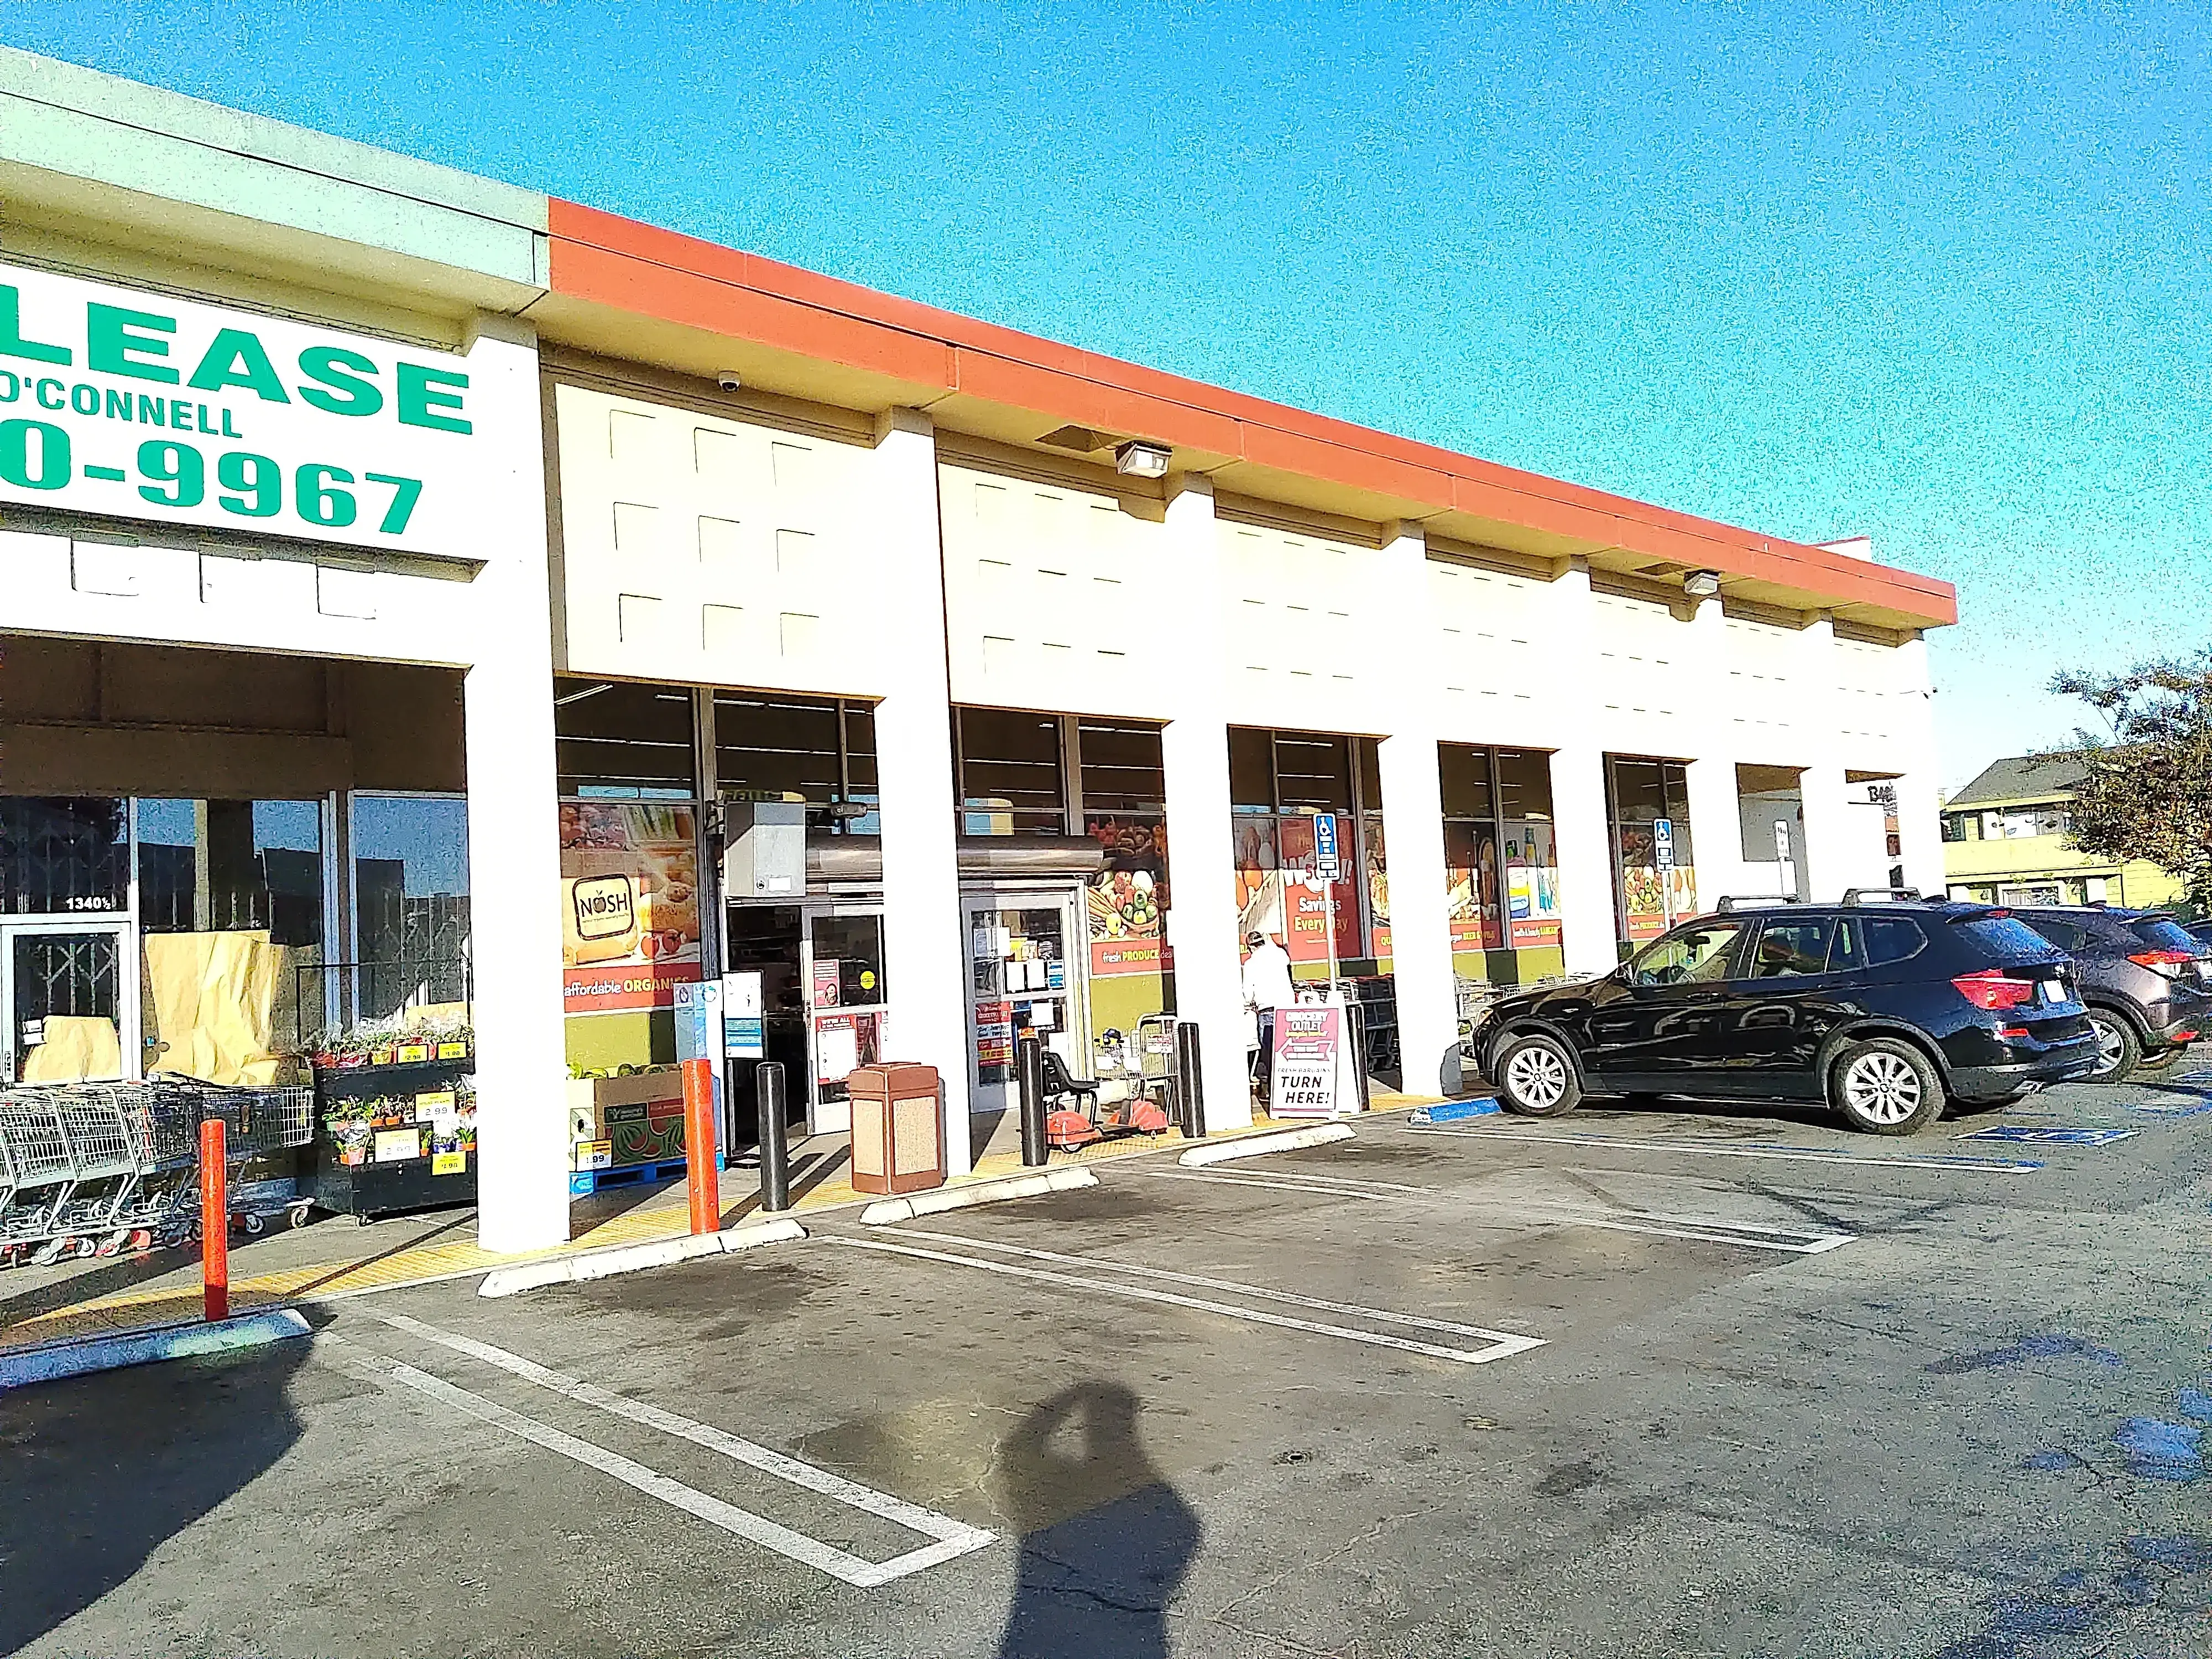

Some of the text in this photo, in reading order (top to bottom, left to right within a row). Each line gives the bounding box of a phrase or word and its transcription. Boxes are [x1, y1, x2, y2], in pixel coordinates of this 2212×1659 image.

[0, 285, 472, 435] LEASE
[0, 370, 242, 438] O'CONNELL
[0, 419, 422, 534] 0-9967
[580, 891, 628, 917] NOSH
[1103, 950, 1122, 963] fresh
[1122, 948, 1160, 962] PRODUCE
[564, 979, 622, 997] affordable
[1281, 1076, 1322, 1088] TURN
[1286, 1092, 1330, 1104] HERE!
